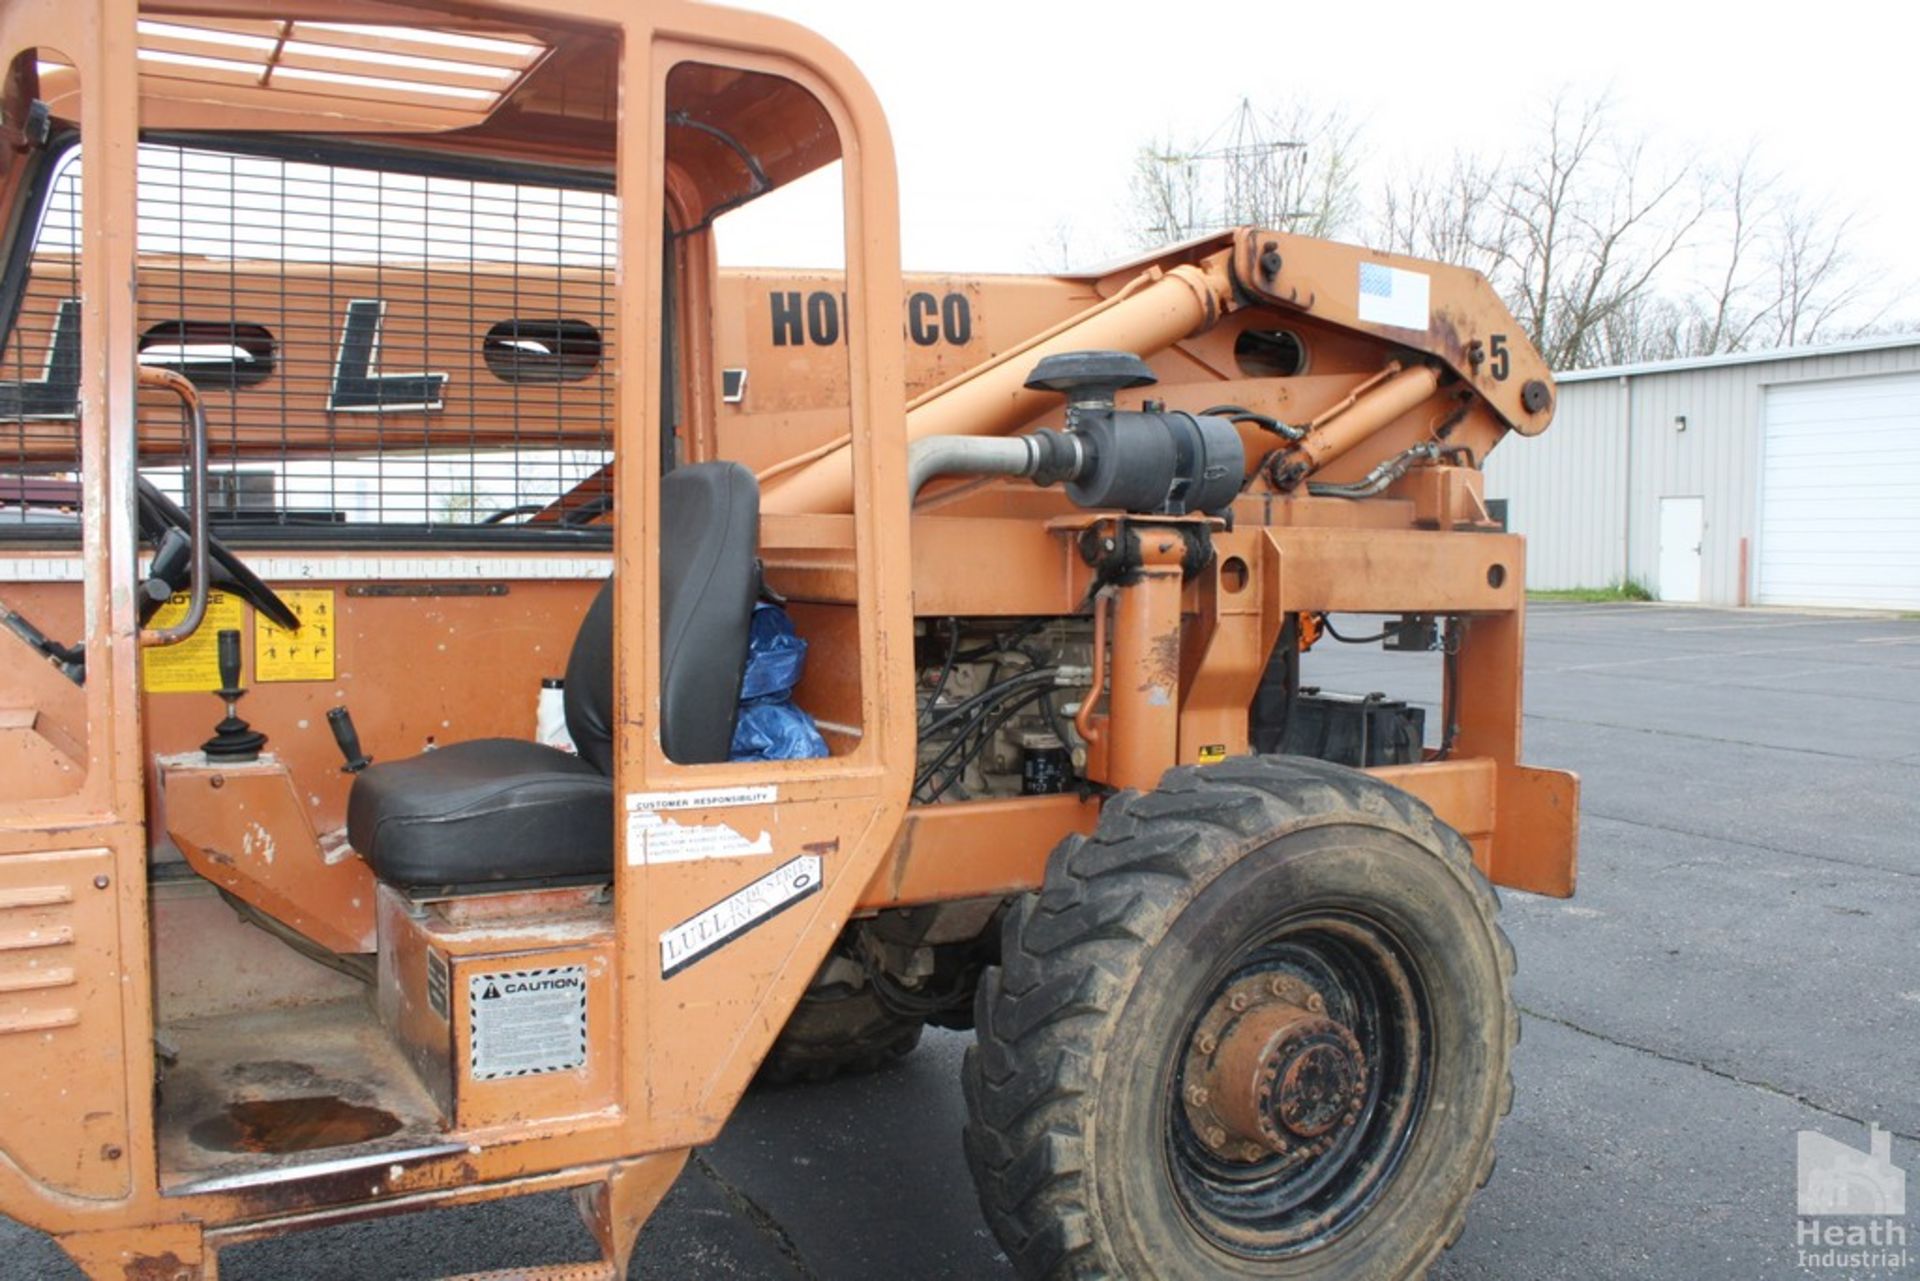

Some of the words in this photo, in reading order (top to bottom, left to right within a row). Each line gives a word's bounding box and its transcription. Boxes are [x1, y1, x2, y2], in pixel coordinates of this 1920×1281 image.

[1490, 334, 1509, 381] 5
[636, 799, 689, 810] CUSTOMER
[693, 793, 768, 805] RESPONSIBILITY
[667, 913, 728, 959] LULL
[505, 977, 579, 994] CAUTION
